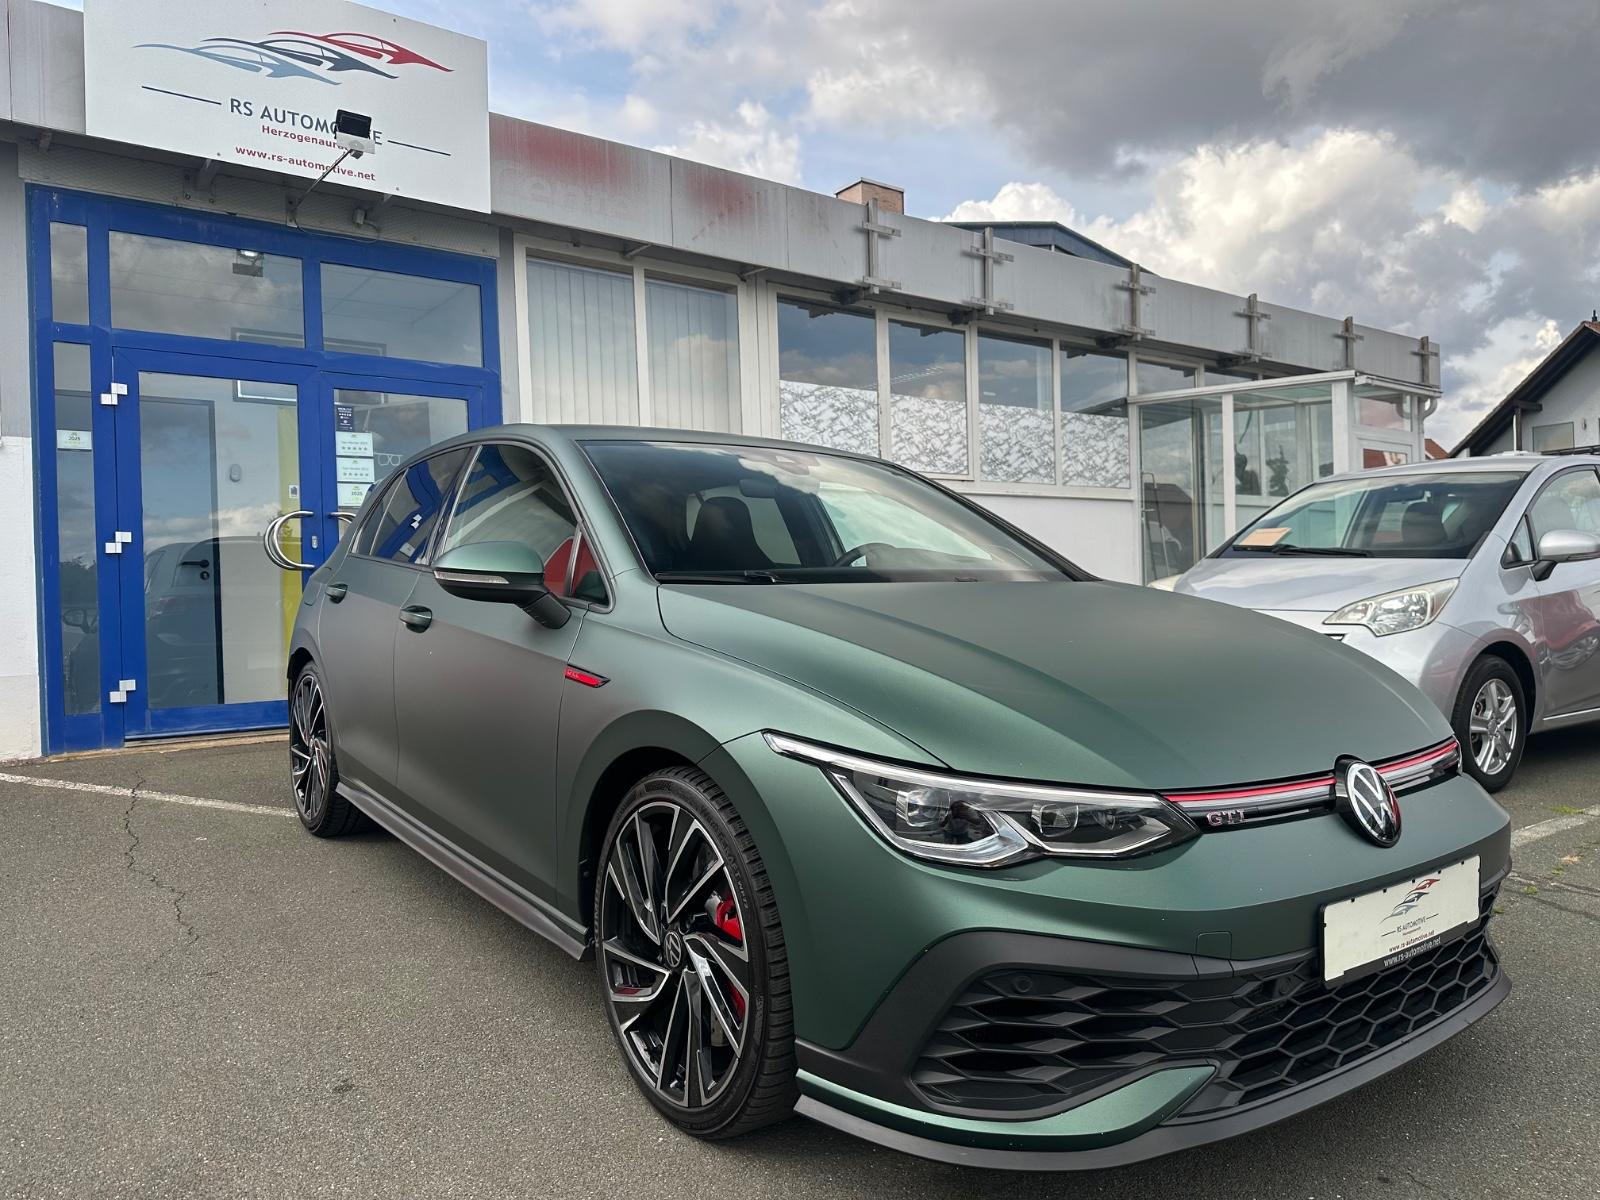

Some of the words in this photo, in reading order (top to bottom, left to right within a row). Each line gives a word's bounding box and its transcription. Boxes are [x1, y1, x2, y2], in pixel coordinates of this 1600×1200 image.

[230, 98, 253, 117] RS
[260, 106, 382, 146] AUTOMOE
[262, 125, 347, 151] Herzogenaur
[235, 146, 376, 181] www.rs-automotive.net
[1206, 808, 1246, 827] GTI
[1383, 936, 1441, 967] www.rs-automotive.net
